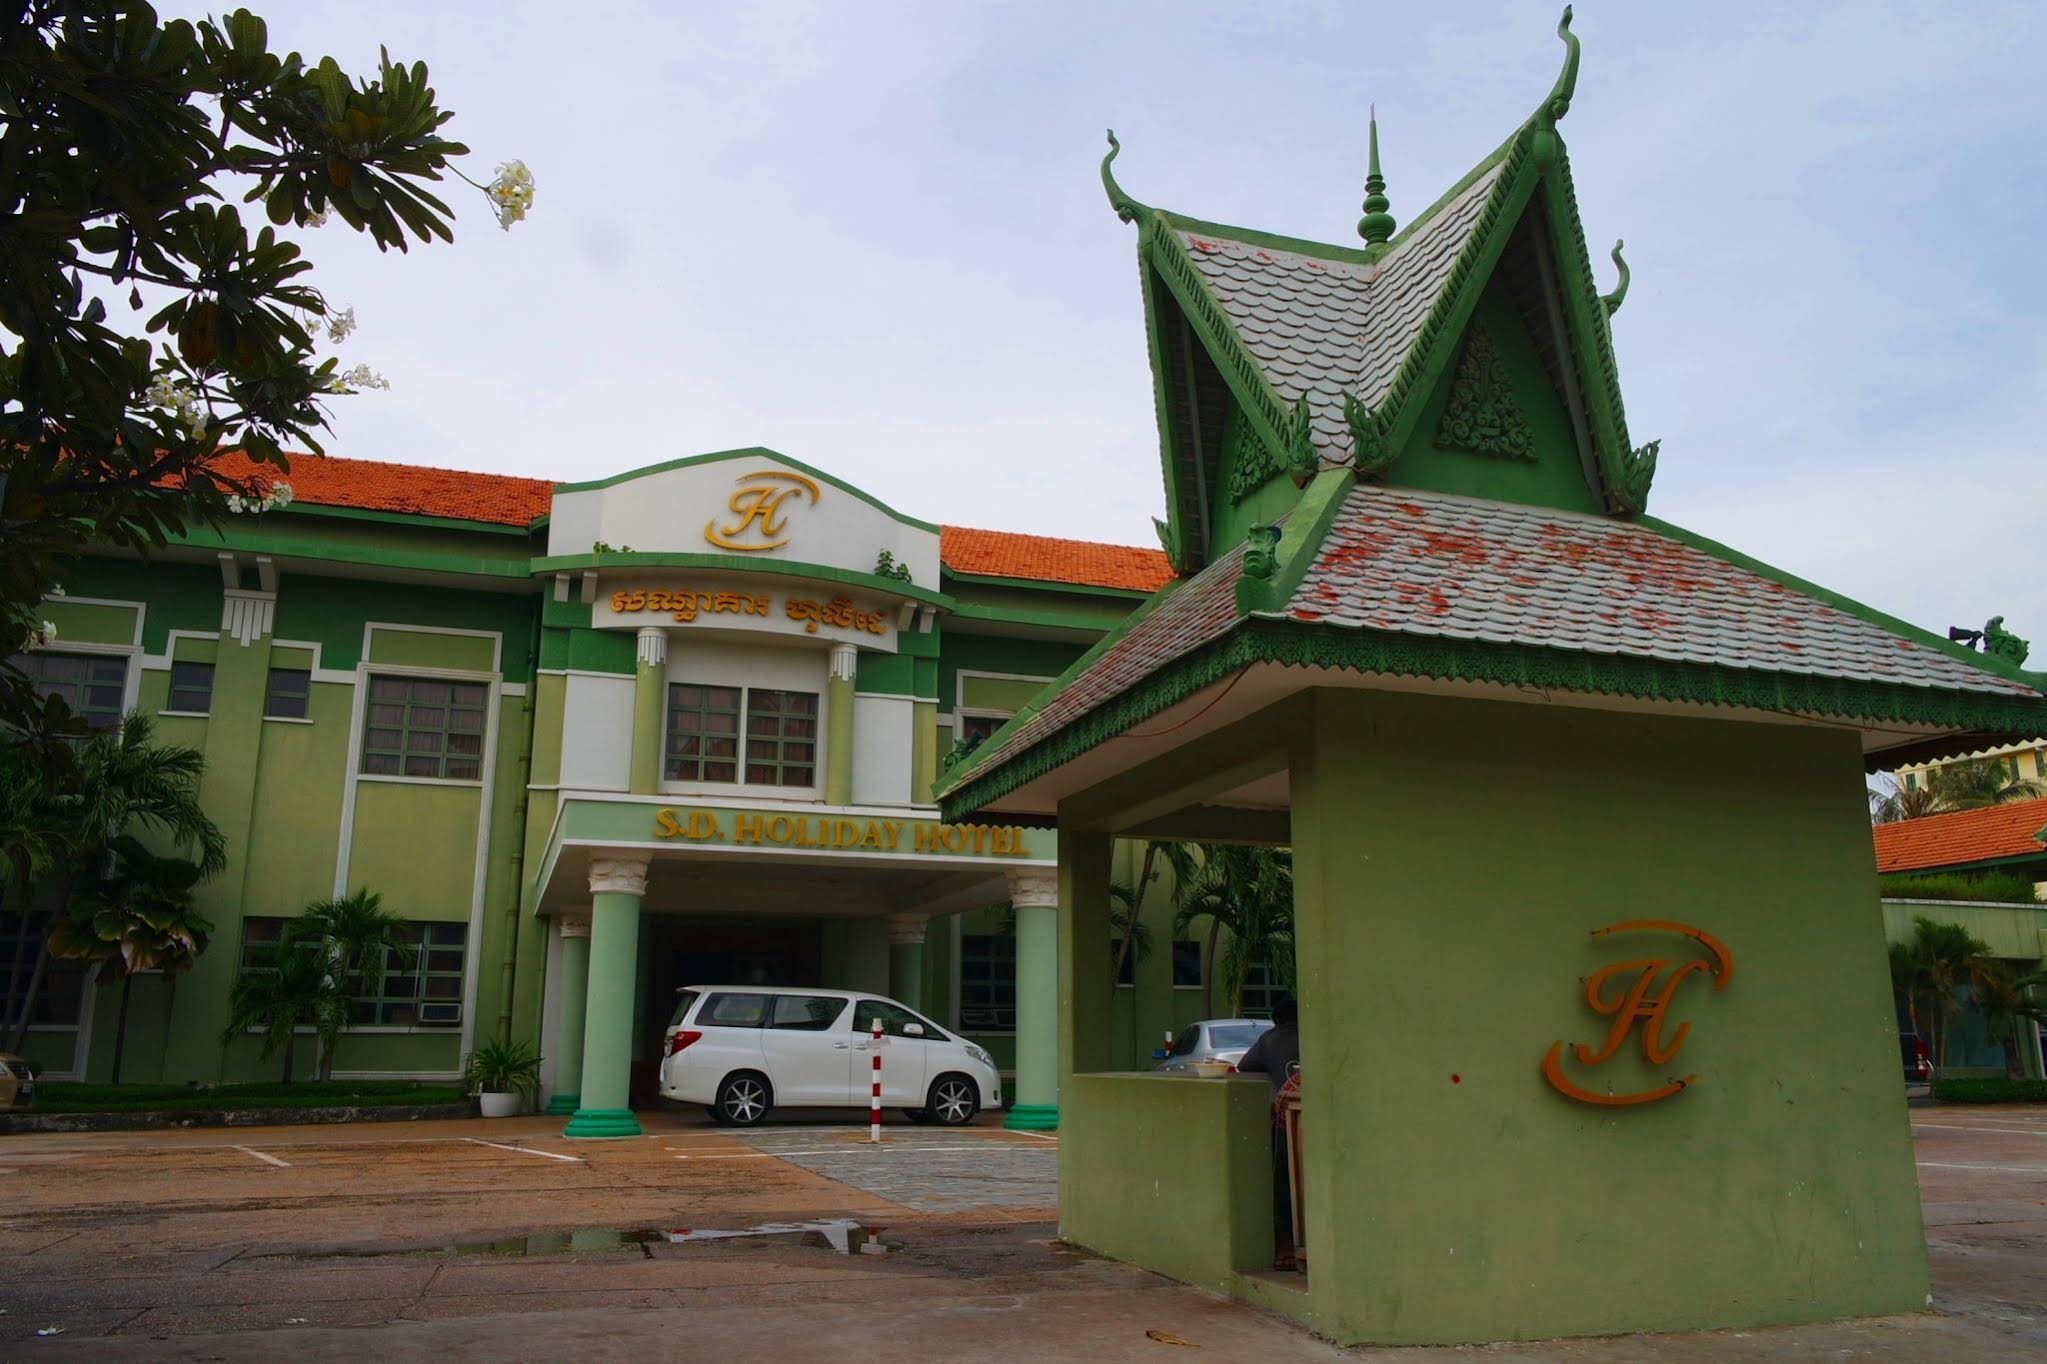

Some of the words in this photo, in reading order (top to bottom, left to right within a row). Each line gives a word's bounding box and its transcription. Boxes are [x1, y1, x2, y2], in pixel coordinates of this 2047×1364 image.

[654, 808, 725, 841] S.D.
[734, 812, 904, 850] HOLIDAY
[914, 823, 1032, 857] HOTEL
